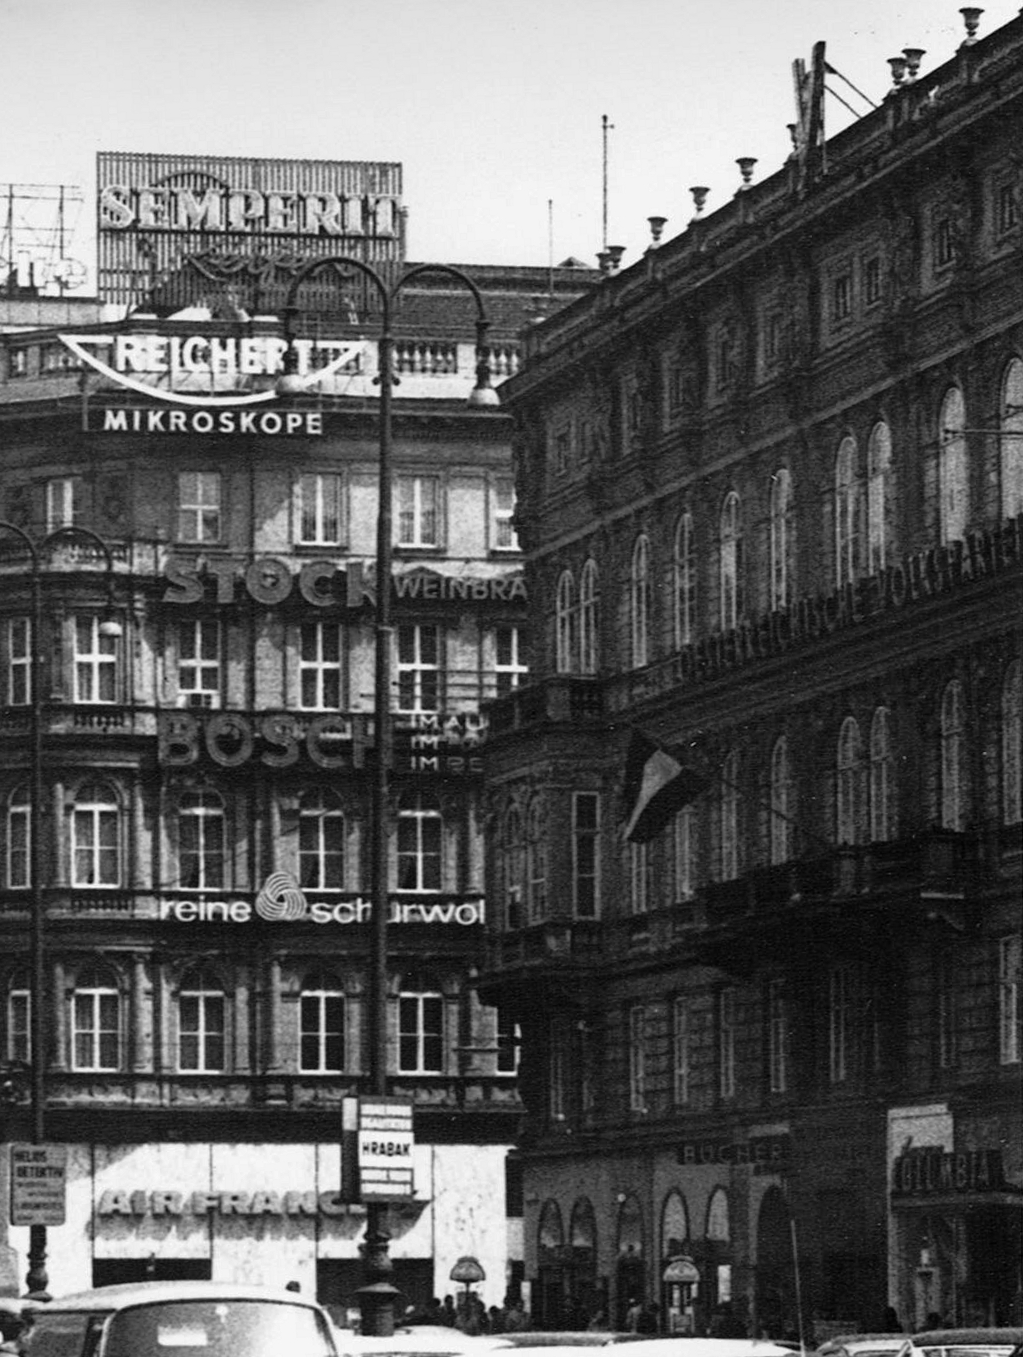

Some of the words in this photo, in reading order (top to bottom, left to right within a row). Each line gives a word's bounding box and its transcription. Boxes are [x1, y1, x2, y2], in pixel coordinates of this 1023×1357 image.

[100, 185, 402, 238] SEMPERIT
[116, 336, 315, 375] REICHERT
[104, 410, 322, 434] MIKROSKOPE
[162, 556, 378, 607] STOCK
[411, 714, 439, 728] IM
[157, 713, 376, 768] BOSCH
[411, 756, 439, 771] IM
[160, 895, 252, 922] reine
[362, 1142, 410, 1157] HRABAK
[98, 1190, 182, 1215] AIR
